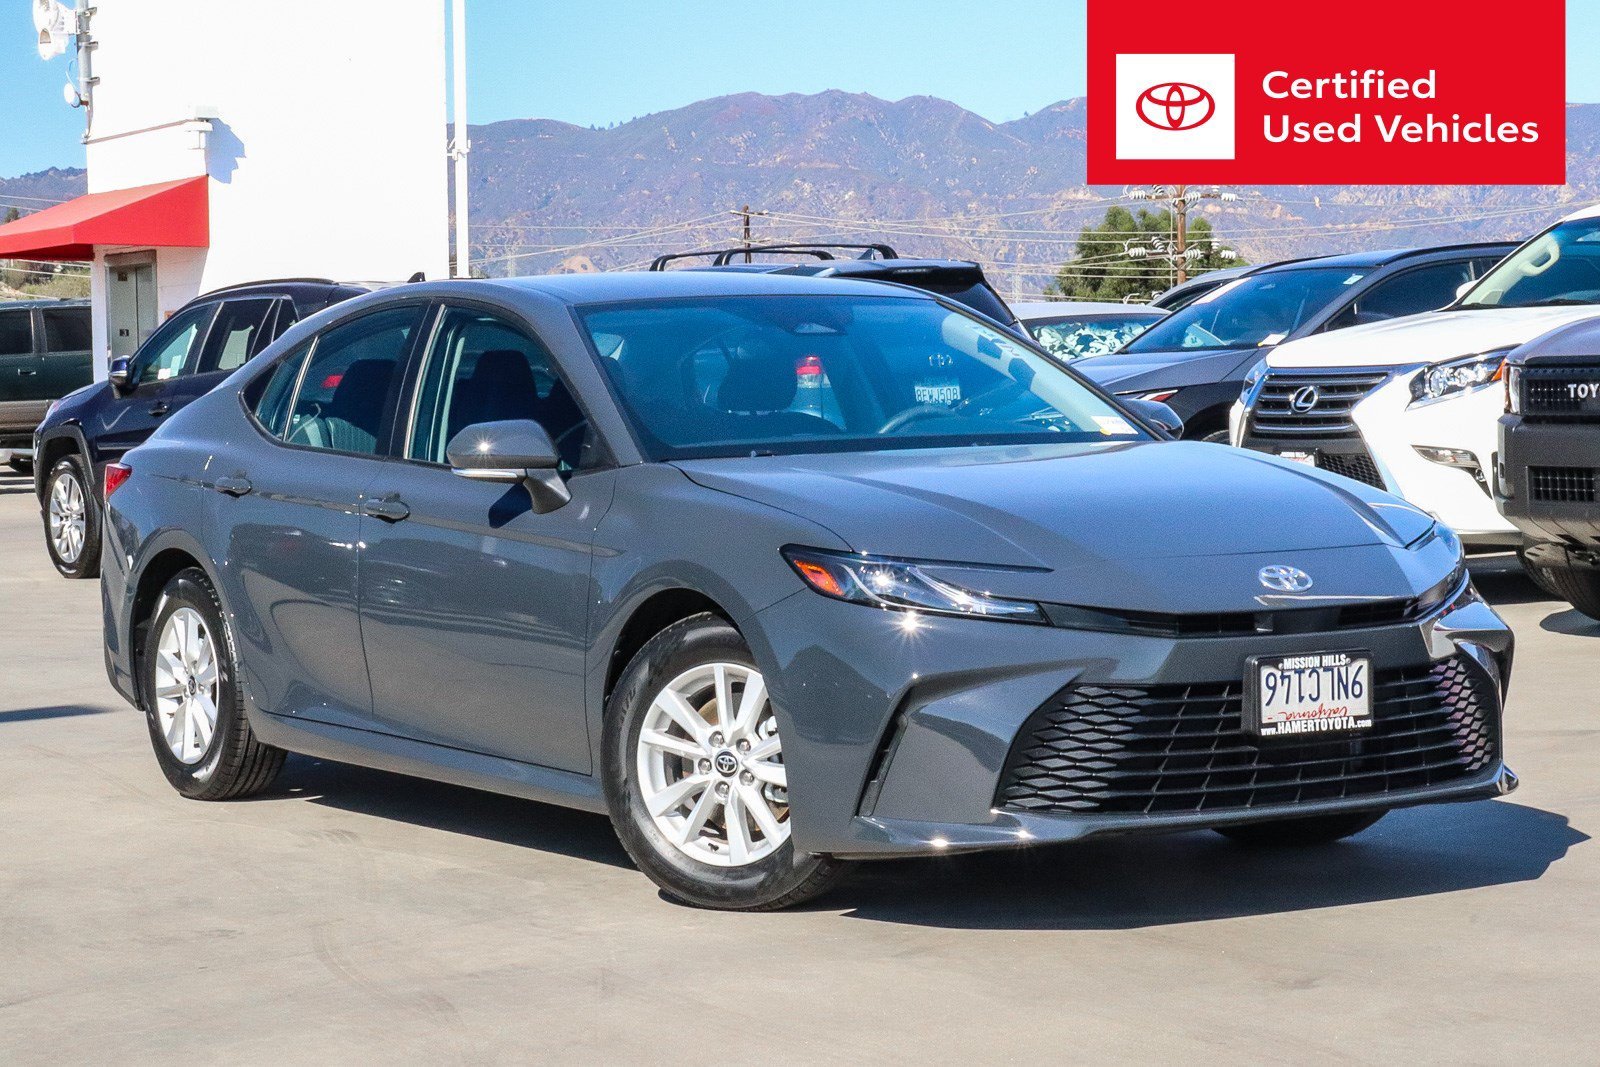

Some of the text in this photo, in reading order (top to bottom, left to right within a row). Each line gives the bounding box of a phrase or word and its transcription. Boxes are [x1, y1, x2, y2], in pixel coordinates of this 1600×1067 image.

[1567, 383, 1600, 398] TOY
[1283, 654, 1346, 669] MISSION HILLS
[1278, 703, 1348, 720] California
[1260, 716, 1372, 736] www.HAMERTOYOTA.com
